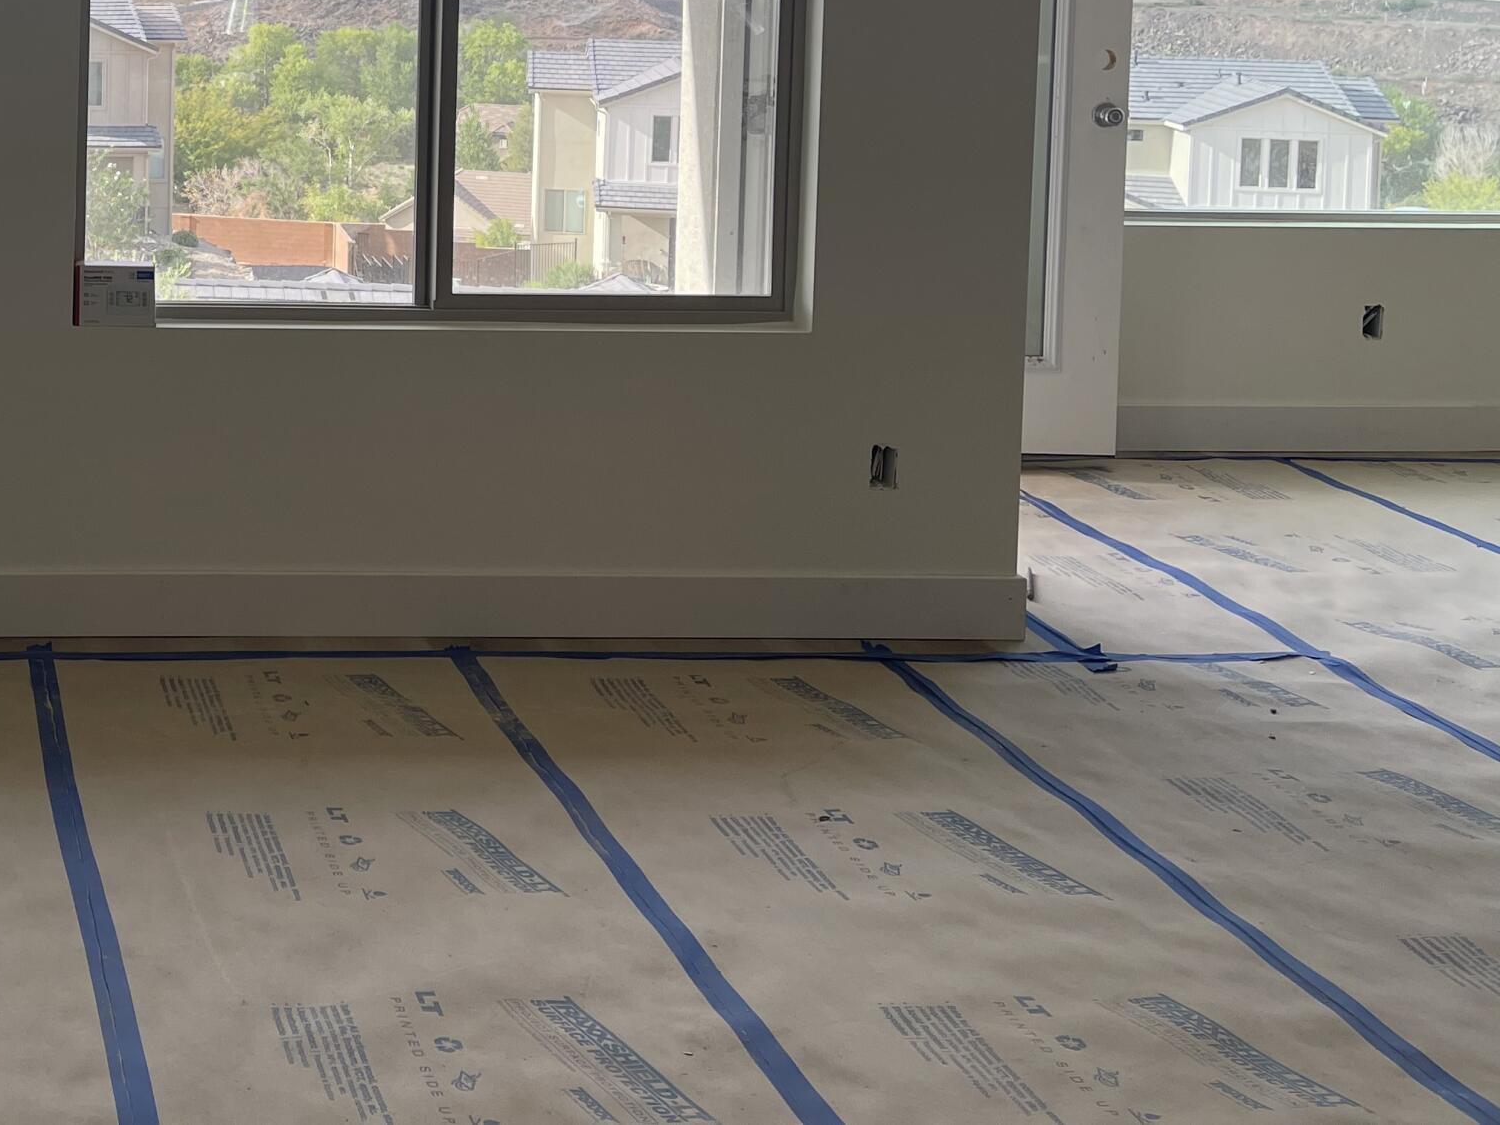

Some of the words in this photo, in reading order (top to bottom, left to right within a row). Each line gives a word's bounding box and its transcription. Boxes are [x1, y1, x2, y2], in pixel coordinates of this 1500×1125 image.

[326, 807, 349, 823] LT
[414, 990, 444, 1017] LT
[1013, 994, 1054, 1017] LT
[390, 996, 425, 1057] PRINTED
[420, 1065, 445, 1099] SIDE
[438, 1106, 456, 1125] UP
[530, 999, 595, 1048] SURFACE
[587, 1048, 682, 1124] PROTECTION
[1055, 1059, 1094, 1092] SIDE
[1095, 1100, 1120, 1116] UP
